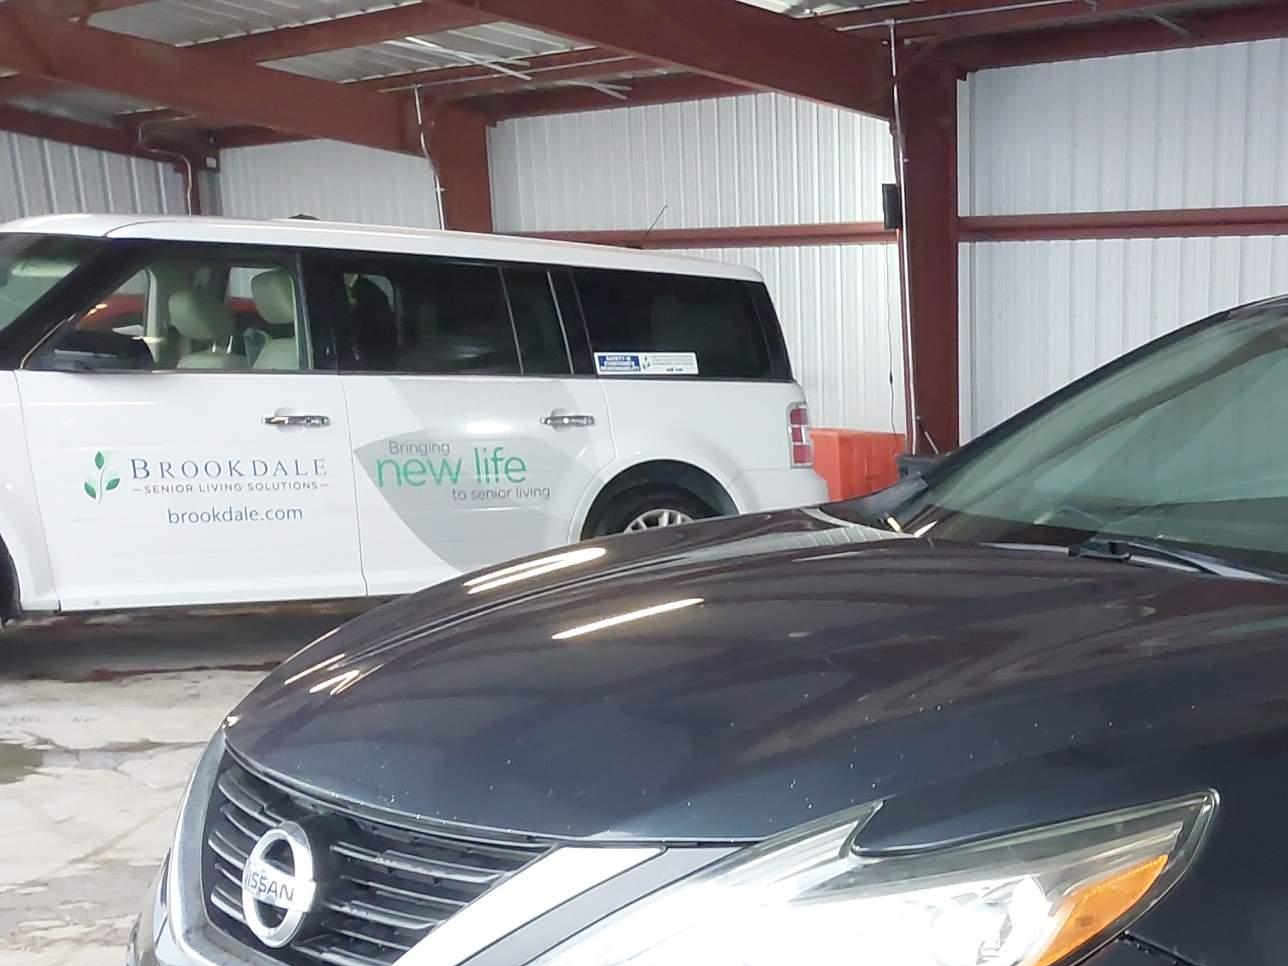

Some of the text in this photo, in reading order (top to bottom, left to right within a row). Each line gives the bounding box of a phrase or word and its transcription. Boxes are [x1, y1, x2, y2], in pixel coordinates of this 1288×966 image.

[389, 440, 450, 456] Bringing
[131, 457, 327, 480] BROOKDALE
[376, 446, 526, 488] new life
[144, 481, 320, 495] SENIOR LIVING SOLUTIONS
[452, 485, 551, 502] to senior living
[168, 505, 303, 525] brookdale.com
